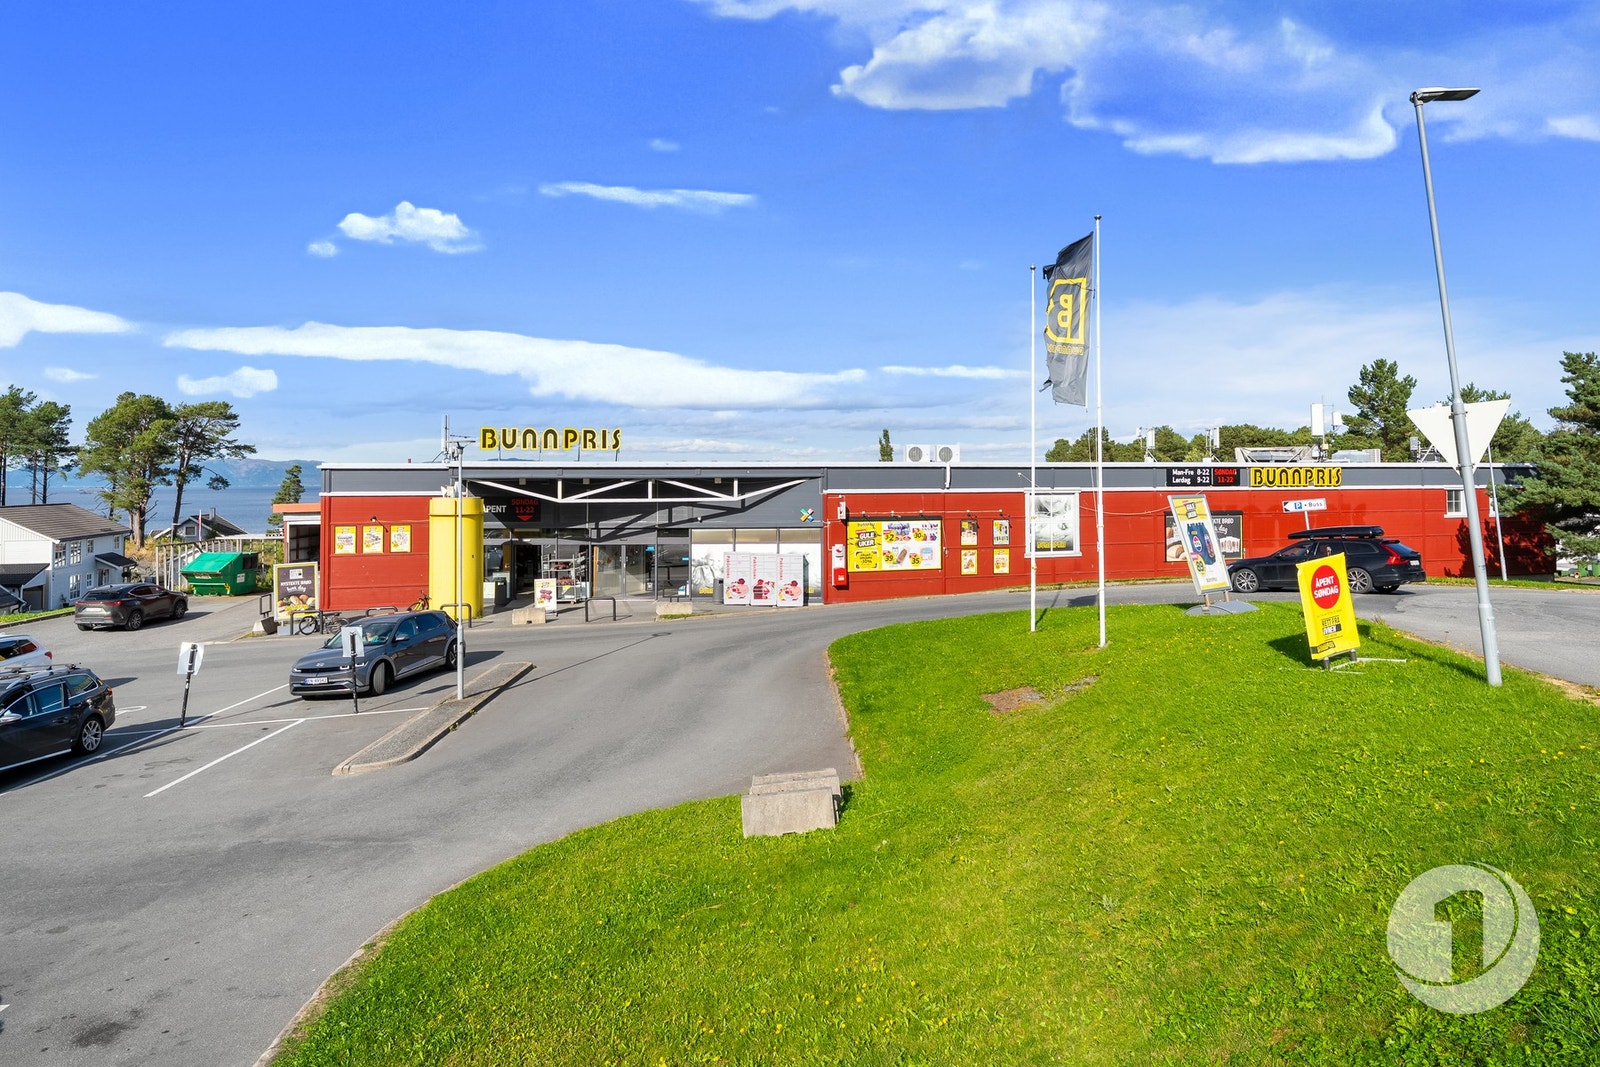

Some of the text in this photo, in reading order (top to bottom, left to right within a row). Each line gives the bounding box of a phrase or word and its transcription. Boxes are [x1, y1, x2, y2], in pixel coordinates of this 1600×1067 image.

[480, 426, 621, 450] BUNNPRIS
[1172, 468, 1194, 476] Man-Fre
[1252, 467, 1341, 487] BUNNPRIS
[1172, 476, 1191, 485] Lørdag
[1315, 576, 1334, 588] ÅPENT
[1313, 585, 1339, 599] SØNDAG
